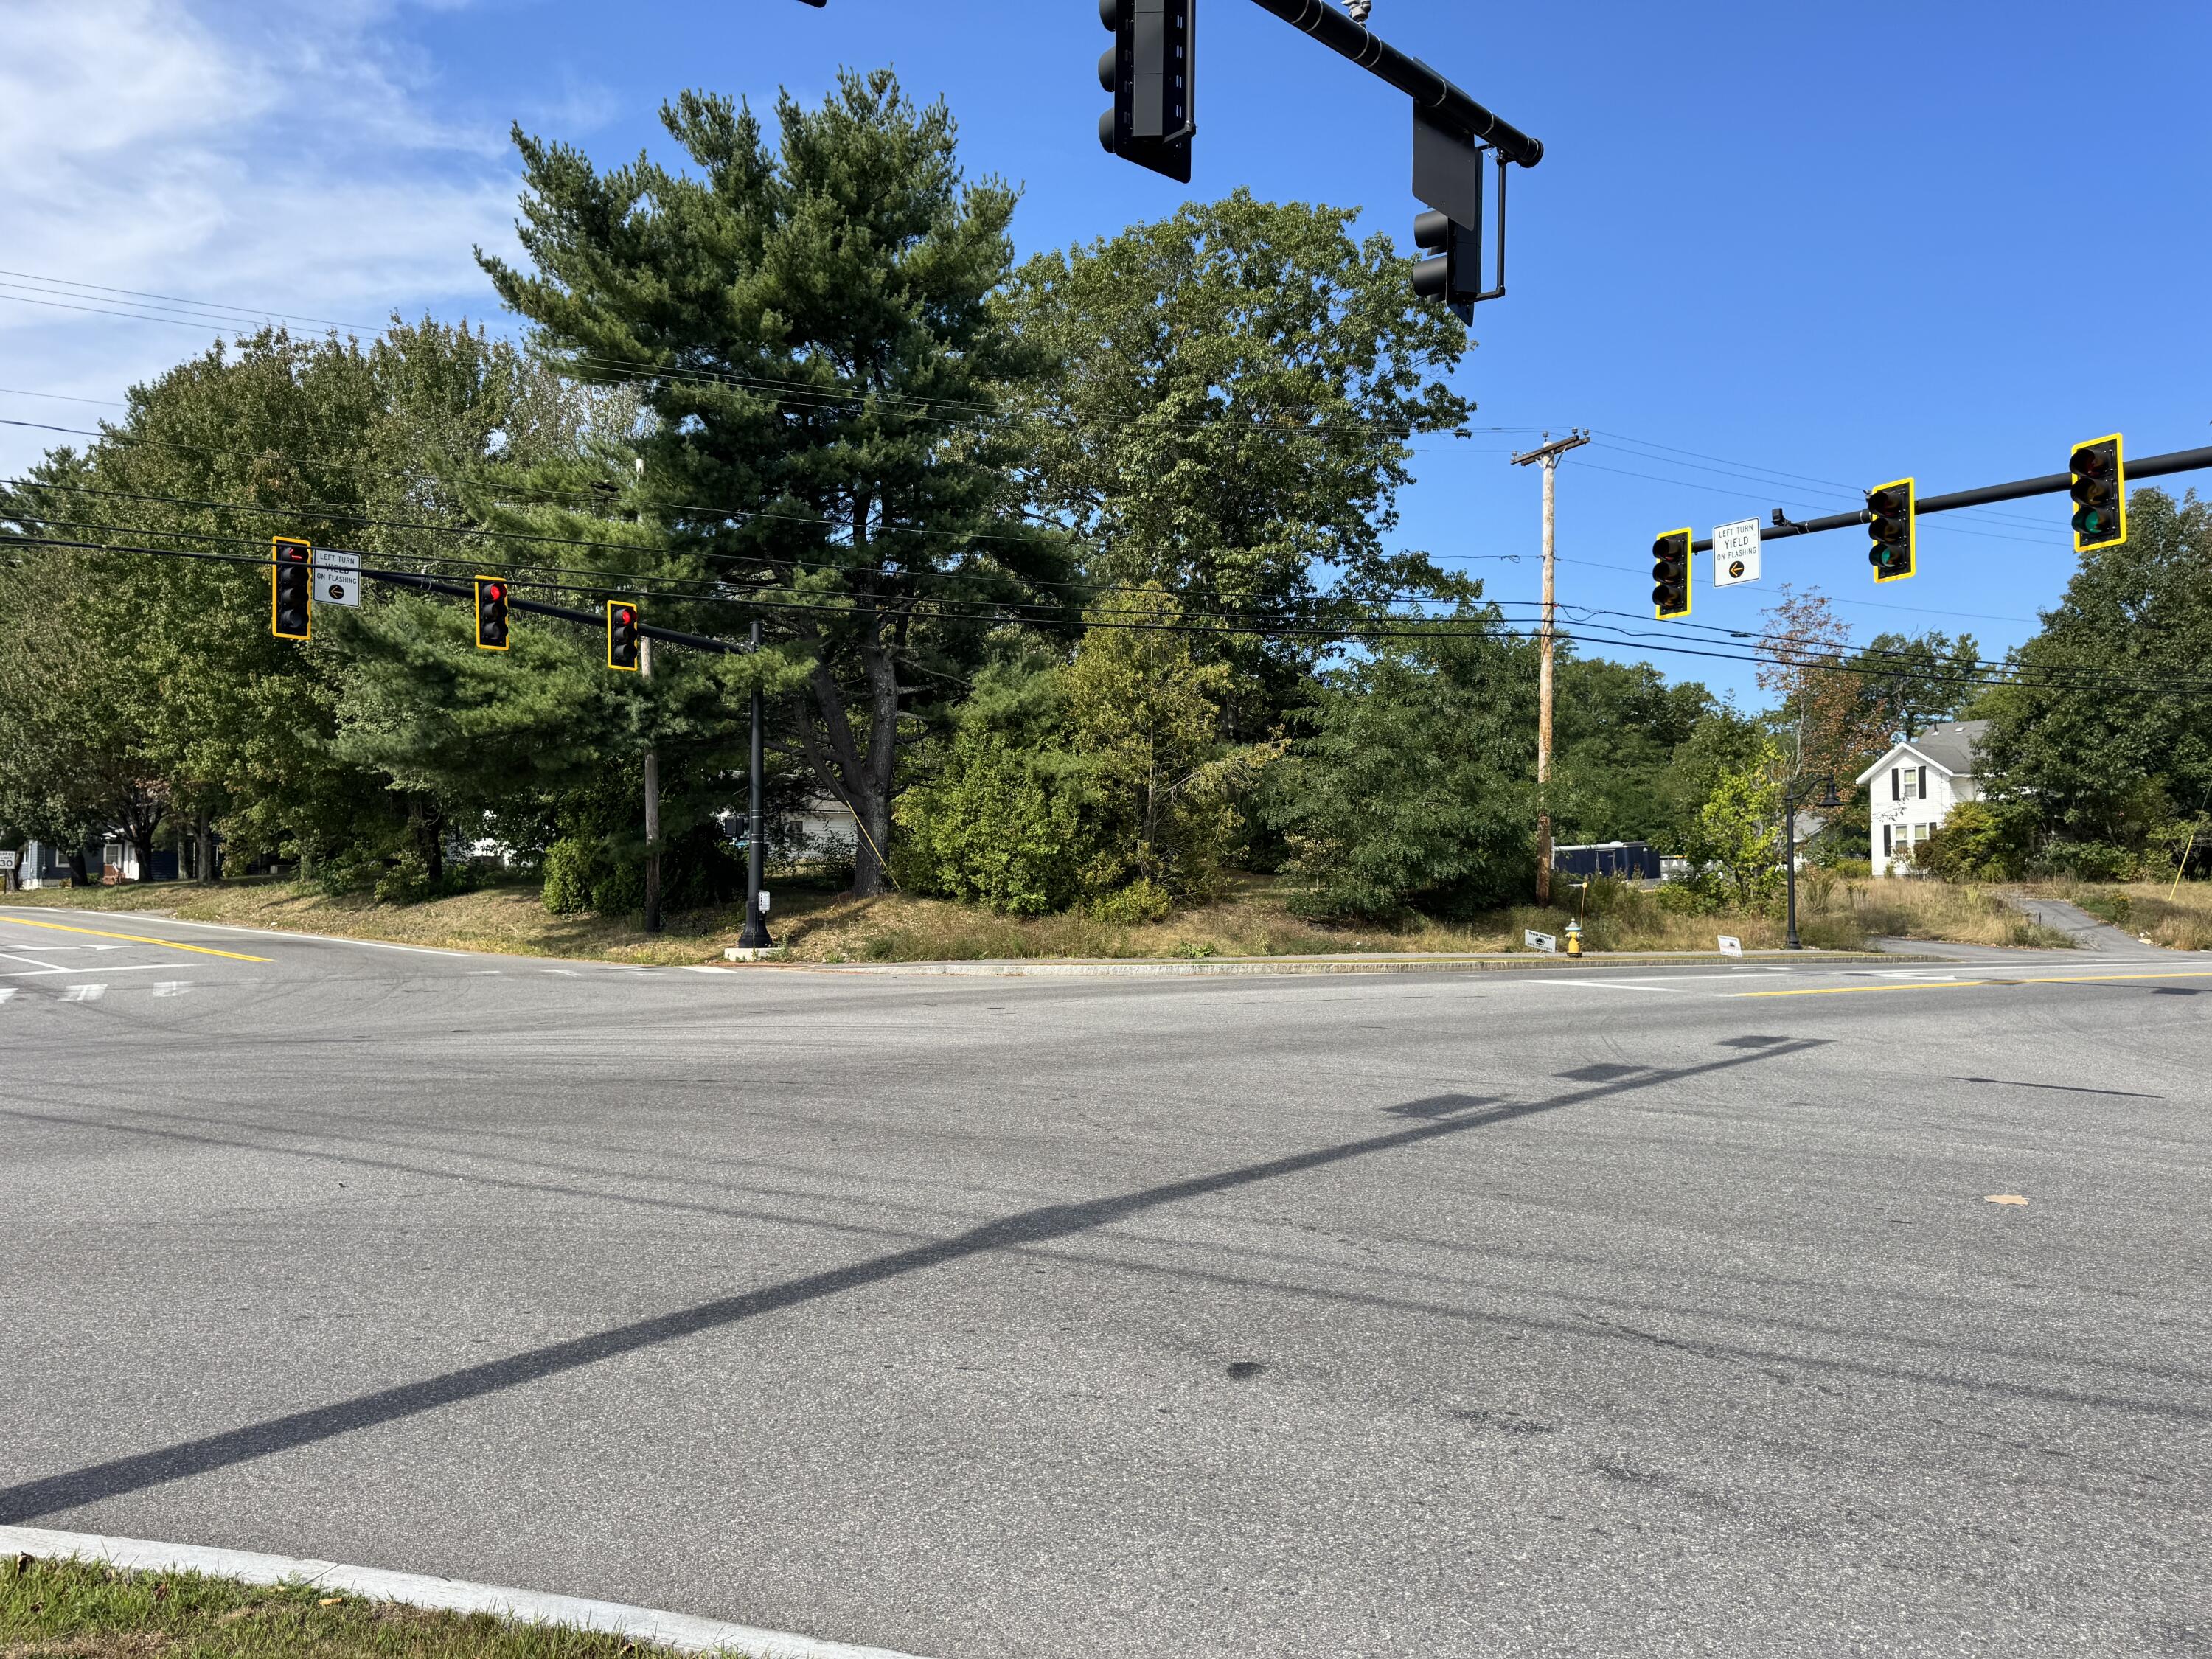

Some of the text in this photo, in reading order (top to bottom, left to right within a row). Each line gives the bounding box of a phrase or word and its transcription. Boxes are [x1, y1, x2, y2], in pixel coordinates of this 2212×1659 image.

[1719, 524, 1753, 538] LEFT TURN
[1725, 536, 1749, 549] YIELD
[320, 552, 355, 565] LEFT TURN
[1717, 546, 1757, 561] ON FLASHING
[328, 574, 357, 585] FLASHING
